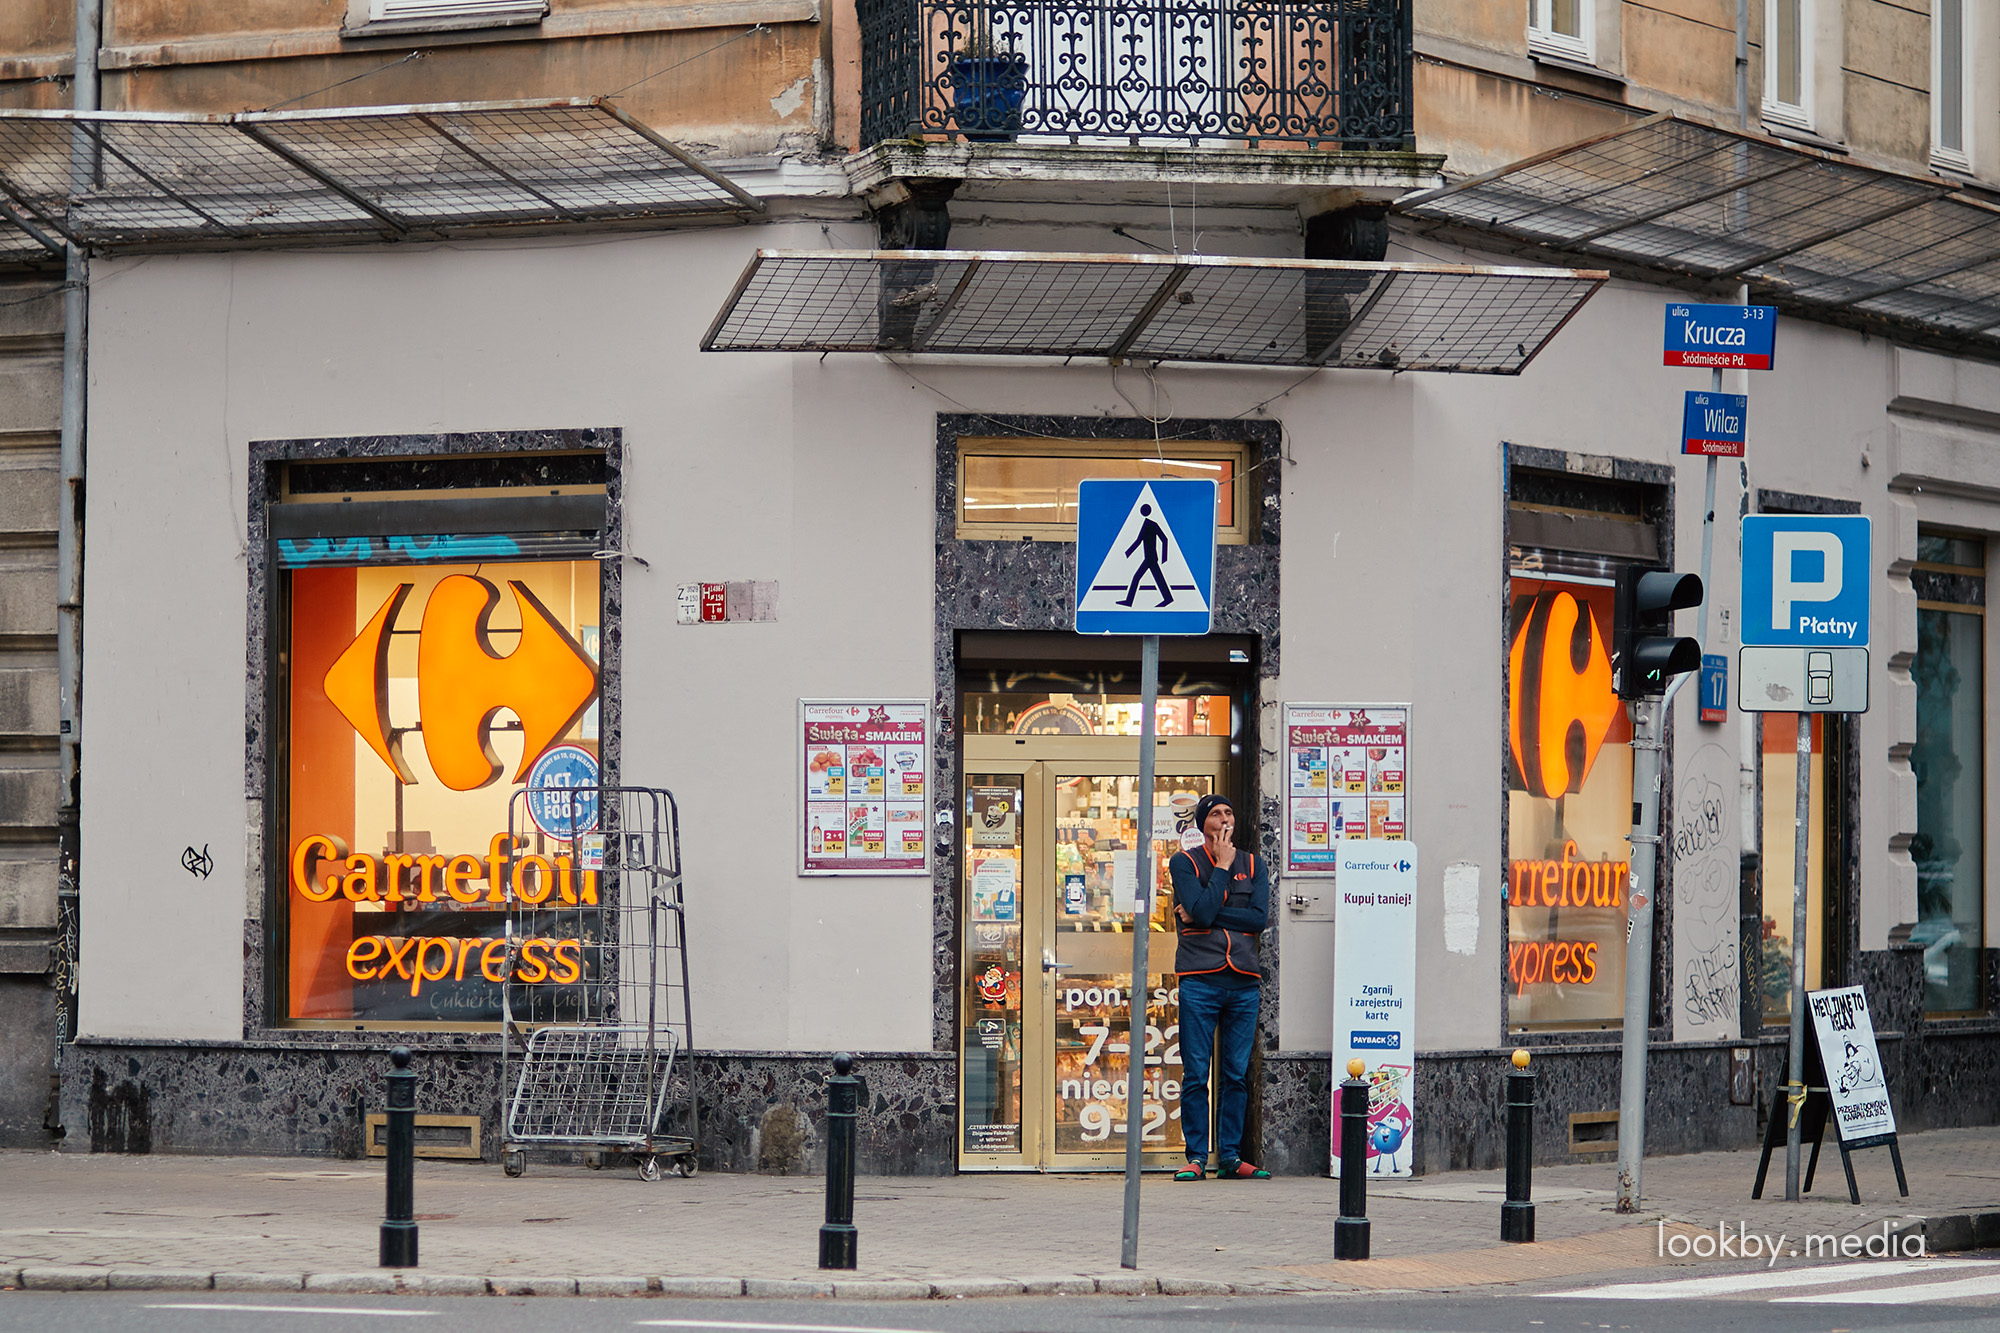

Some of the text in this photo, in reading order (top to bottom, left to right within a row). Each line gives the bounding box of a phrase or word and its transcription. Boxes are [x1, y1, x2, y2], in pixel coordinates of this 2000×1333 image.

[1672, 306, 1764, 320] ulica 3-13
[1684, 320, 1746, 346] Krucza
[1682, 351, 1746, 366] Śródmieście Pd.
[1695, 394, 1709, 405] ulica
[1704, 408, 1738, 434] Wilcza
[1772, 532, 1843, 630] P
[1800, 616, 1858, 638] Płatny
[1711, 672, 1724, 706] 17
[809, 723, 858, 744] Święta
[865, 732, 922, 741] SMAKIEM
[1292, 726, 1340, 747] Święta
[1346, 734, 1402, 744] SMAKIEM
[543, 772, 572, 788] ACT
[544, 791, 571, 804] FOR
[544, 803, 582, 820] FOOD
[292, 832, 598, 904] Carrefou
[1344, 861, 1390, 870] Carrefour
[1510, 840, 1628, 907] rrefour
[1344, 892, 1412, 906] Kupuj taniej!
[346, 936, 581, 996] express
[1509, 942, 1598, 999] xpress
[1066, 988, 1128, 1012] pon.
[1362, 985, 1392, 996] Zgarnij
[1350, 997, 1402, 1009] i zarejestruj
[1831, 994, 1853, 1014] TIME
[1851, 993, 1864, 1011] TO
[1366, 1010, 1389, 1021] kartę
[1062, 1072, 1181, 1100] niedzie
